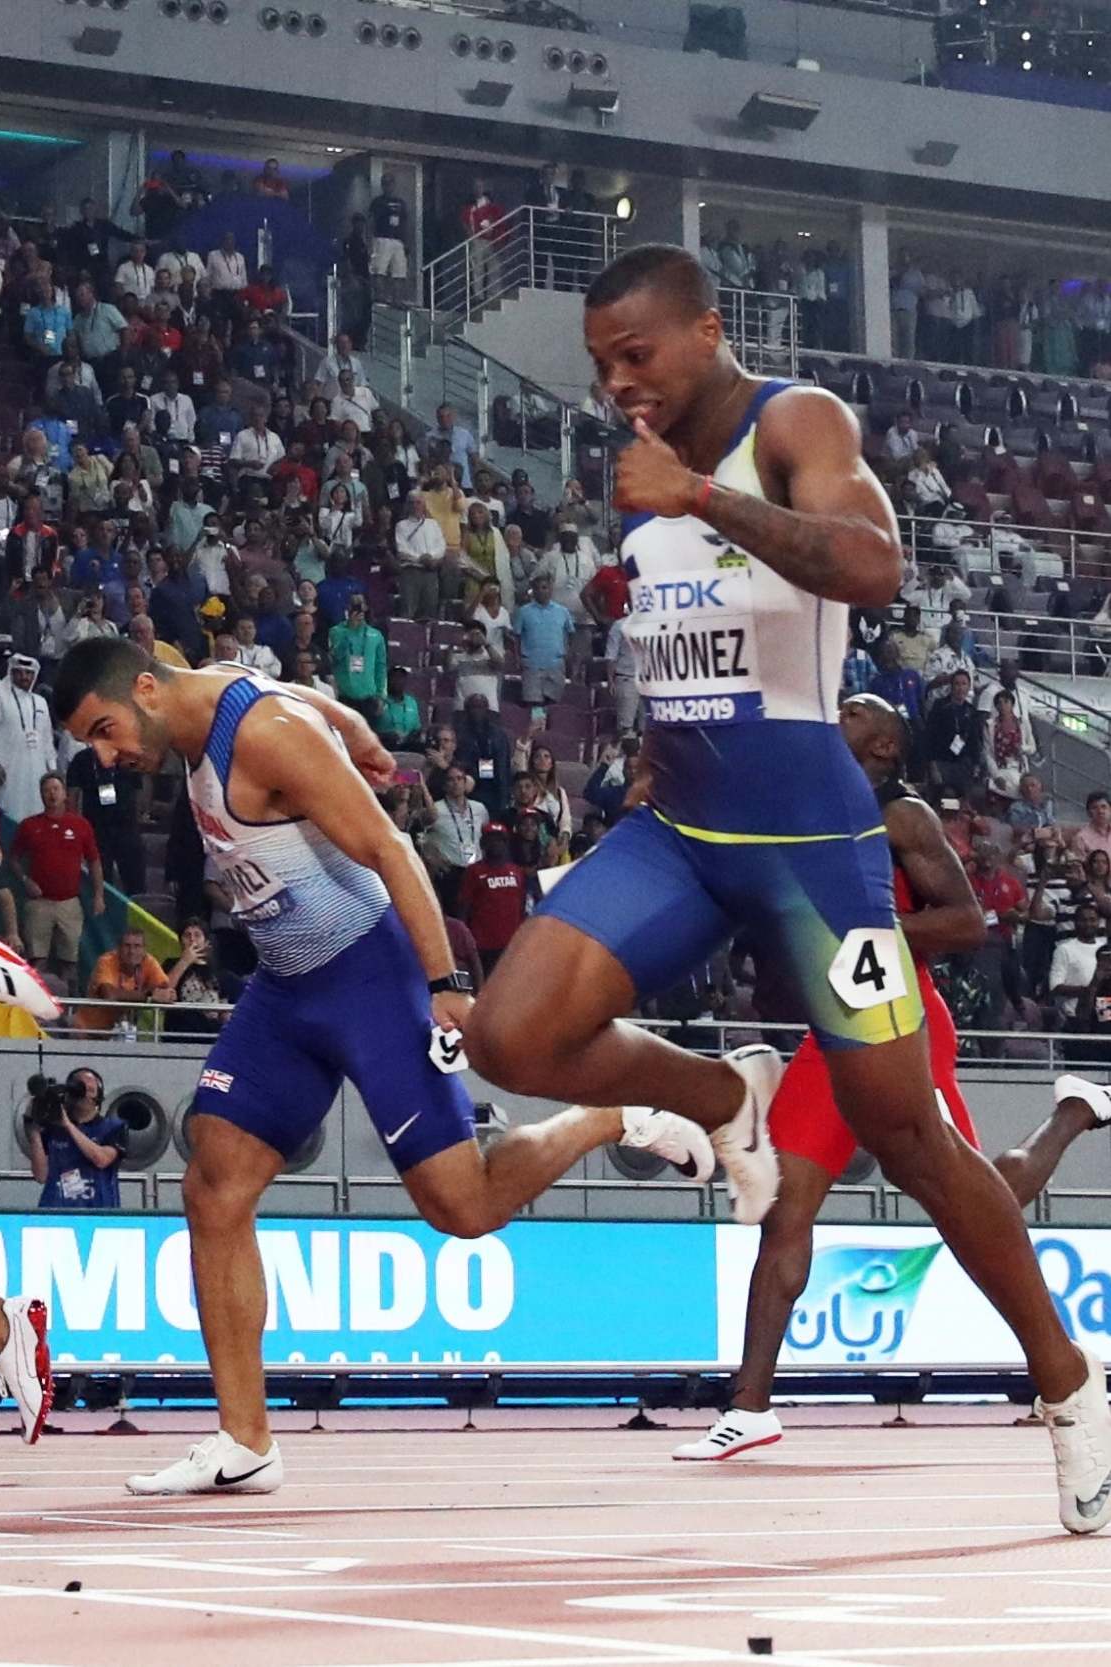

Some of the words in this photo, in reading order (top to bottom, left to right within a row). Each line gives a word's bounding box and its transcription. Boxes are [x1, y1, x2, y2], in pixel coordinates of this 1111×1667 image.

[654, 579, 726, 611] TDK
[487, 875, 518, 889] QATAR
[852, 939, 887, 992] 4
